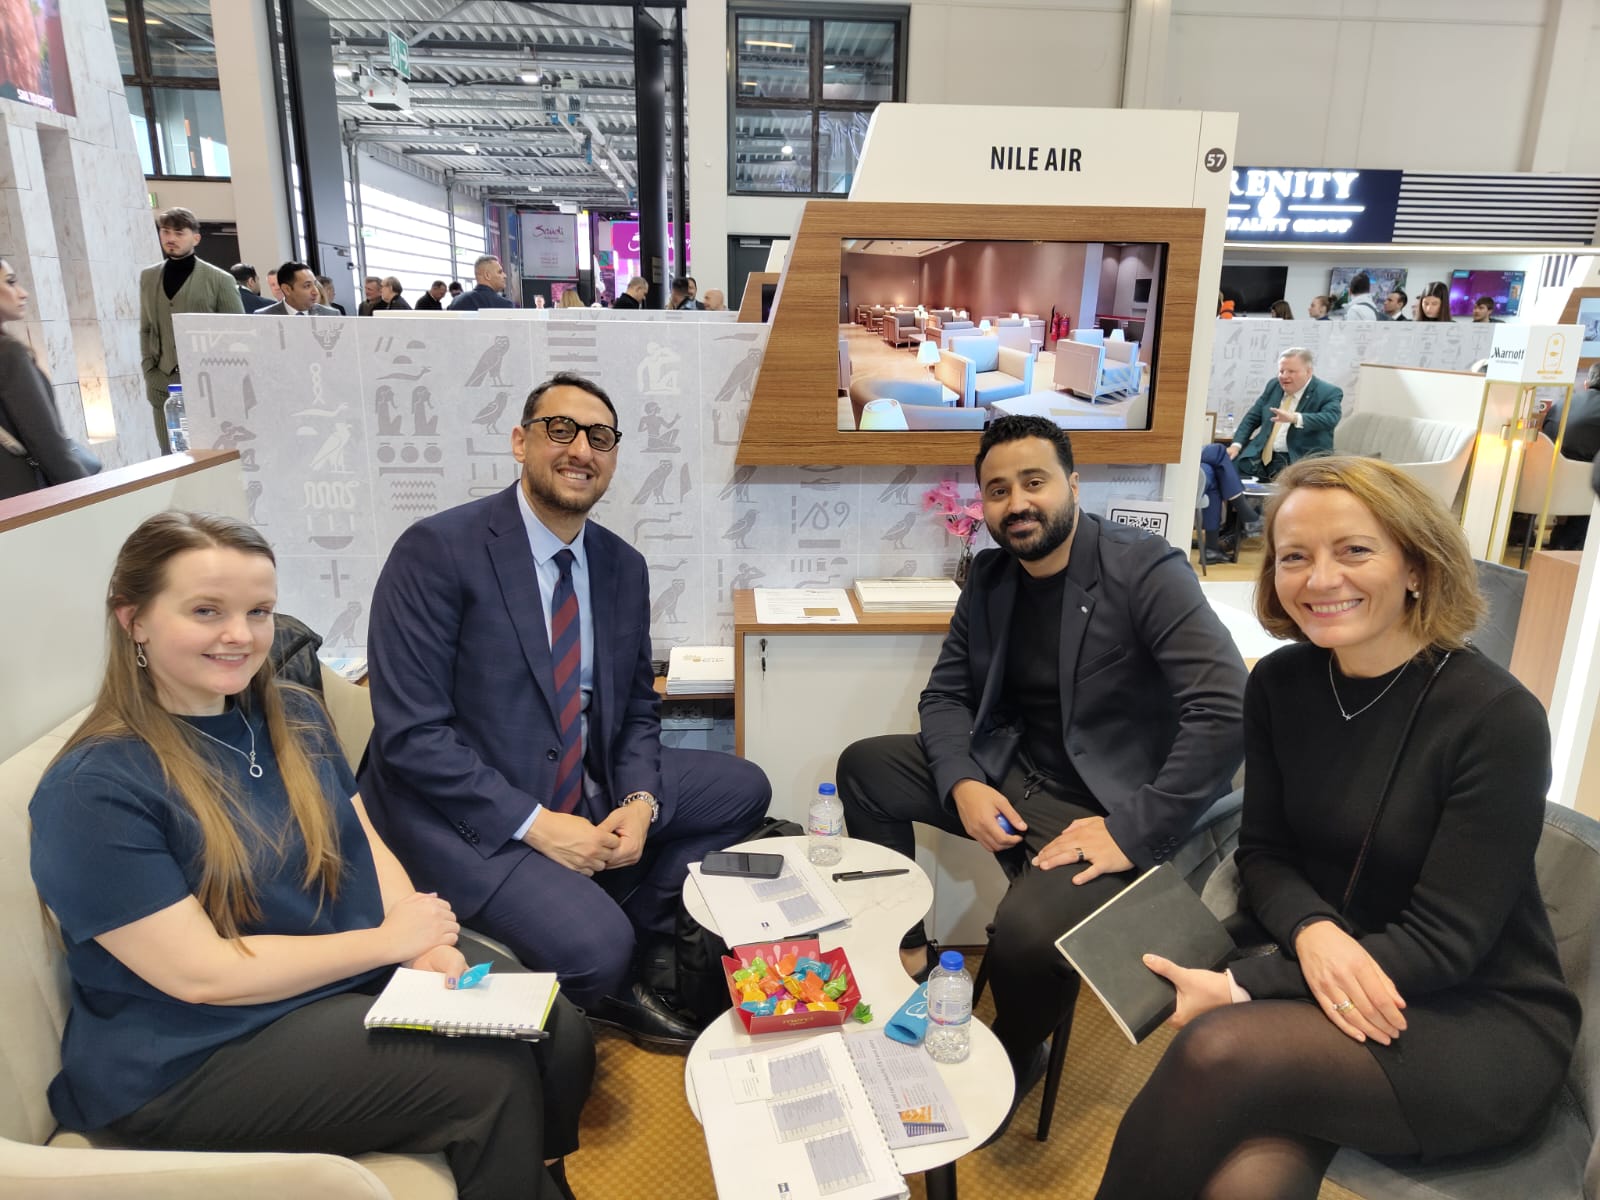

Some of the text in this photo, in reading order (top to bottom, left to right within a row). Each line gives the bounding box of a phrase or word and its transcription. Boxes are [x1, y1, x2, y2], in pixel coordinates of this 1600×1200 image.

[990, 146, 1082, 172] NILE AIR
[1206, 153, 1225, 168] 57
[1490, 346, 1525, 360] Marriott
